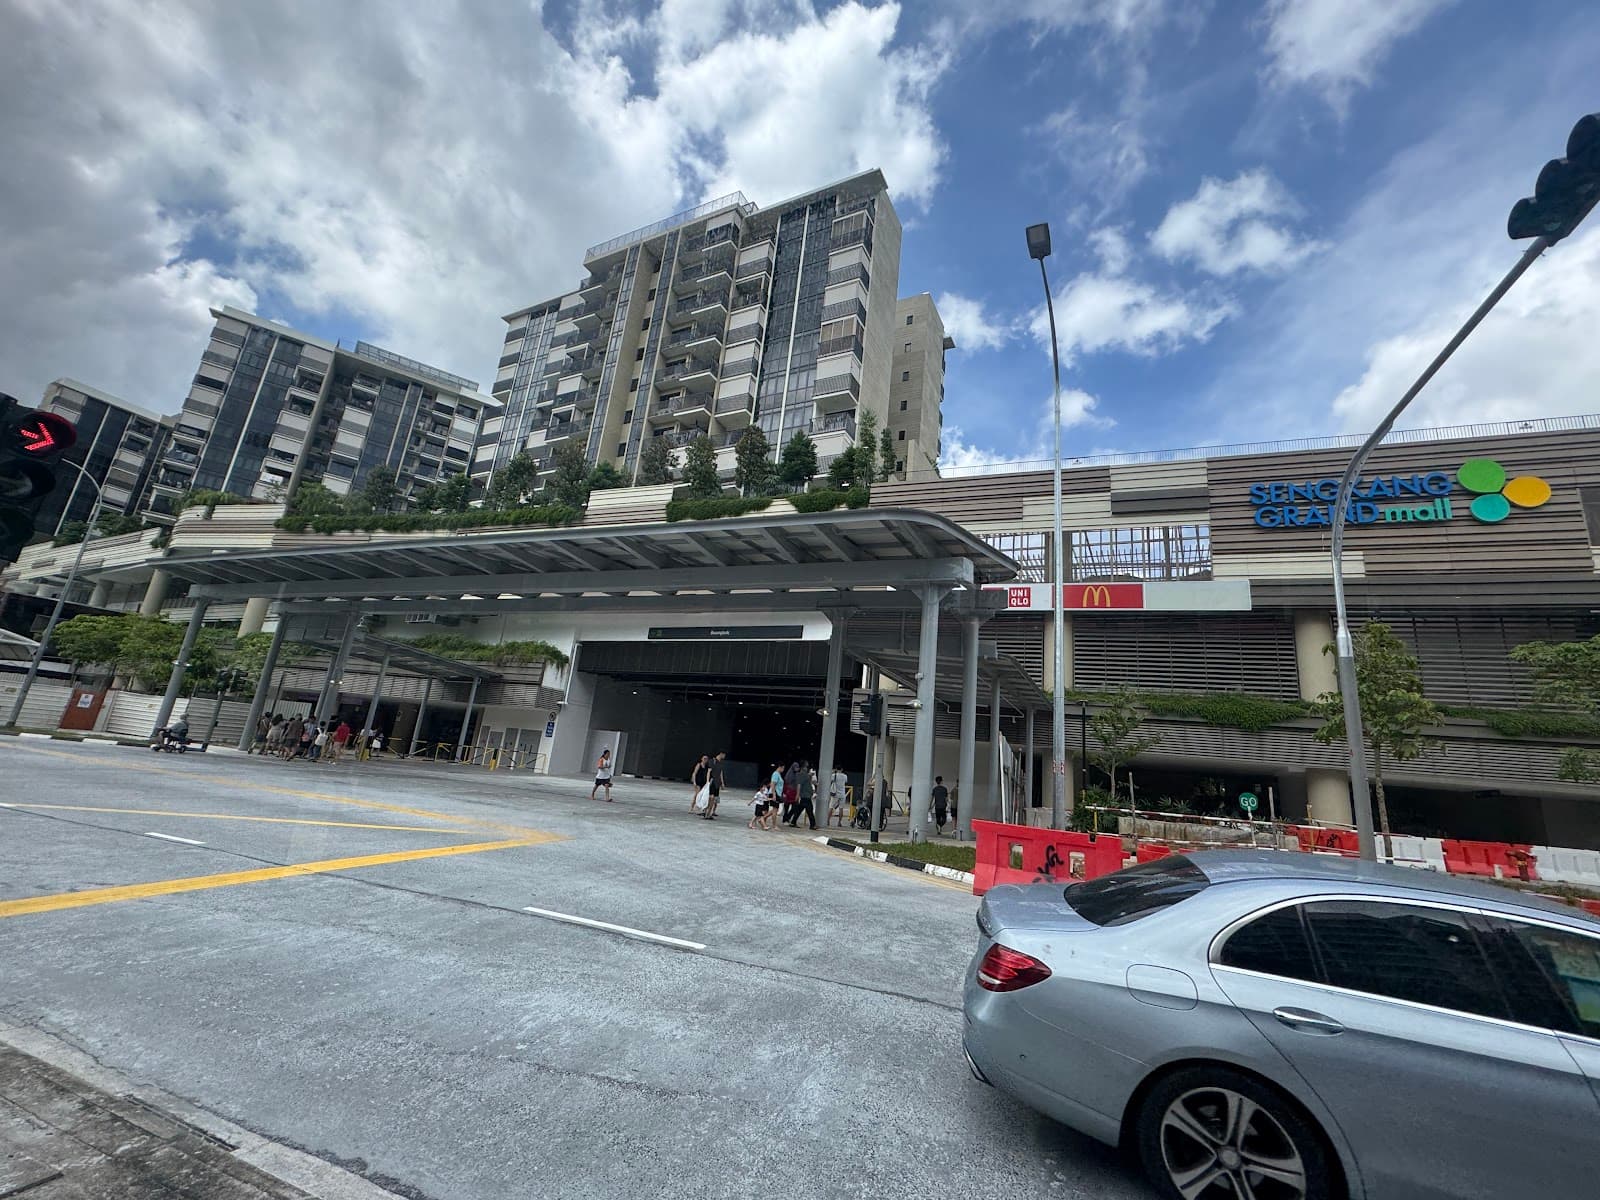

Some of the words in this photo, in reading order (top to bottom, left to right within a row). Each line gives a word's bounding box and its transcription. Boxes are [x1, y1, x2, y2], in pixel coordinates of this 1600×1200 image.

[1249, 471, 1453, 505] SENGKANG
[1254, 500, 1380, 528] GRAND
[1384, 497, 1453, 523] mall
[1010, 589, 1027, 597] UNI
[1010, 597, 1028, 606] QLO
[1240, 797, 1256, 807] GO
